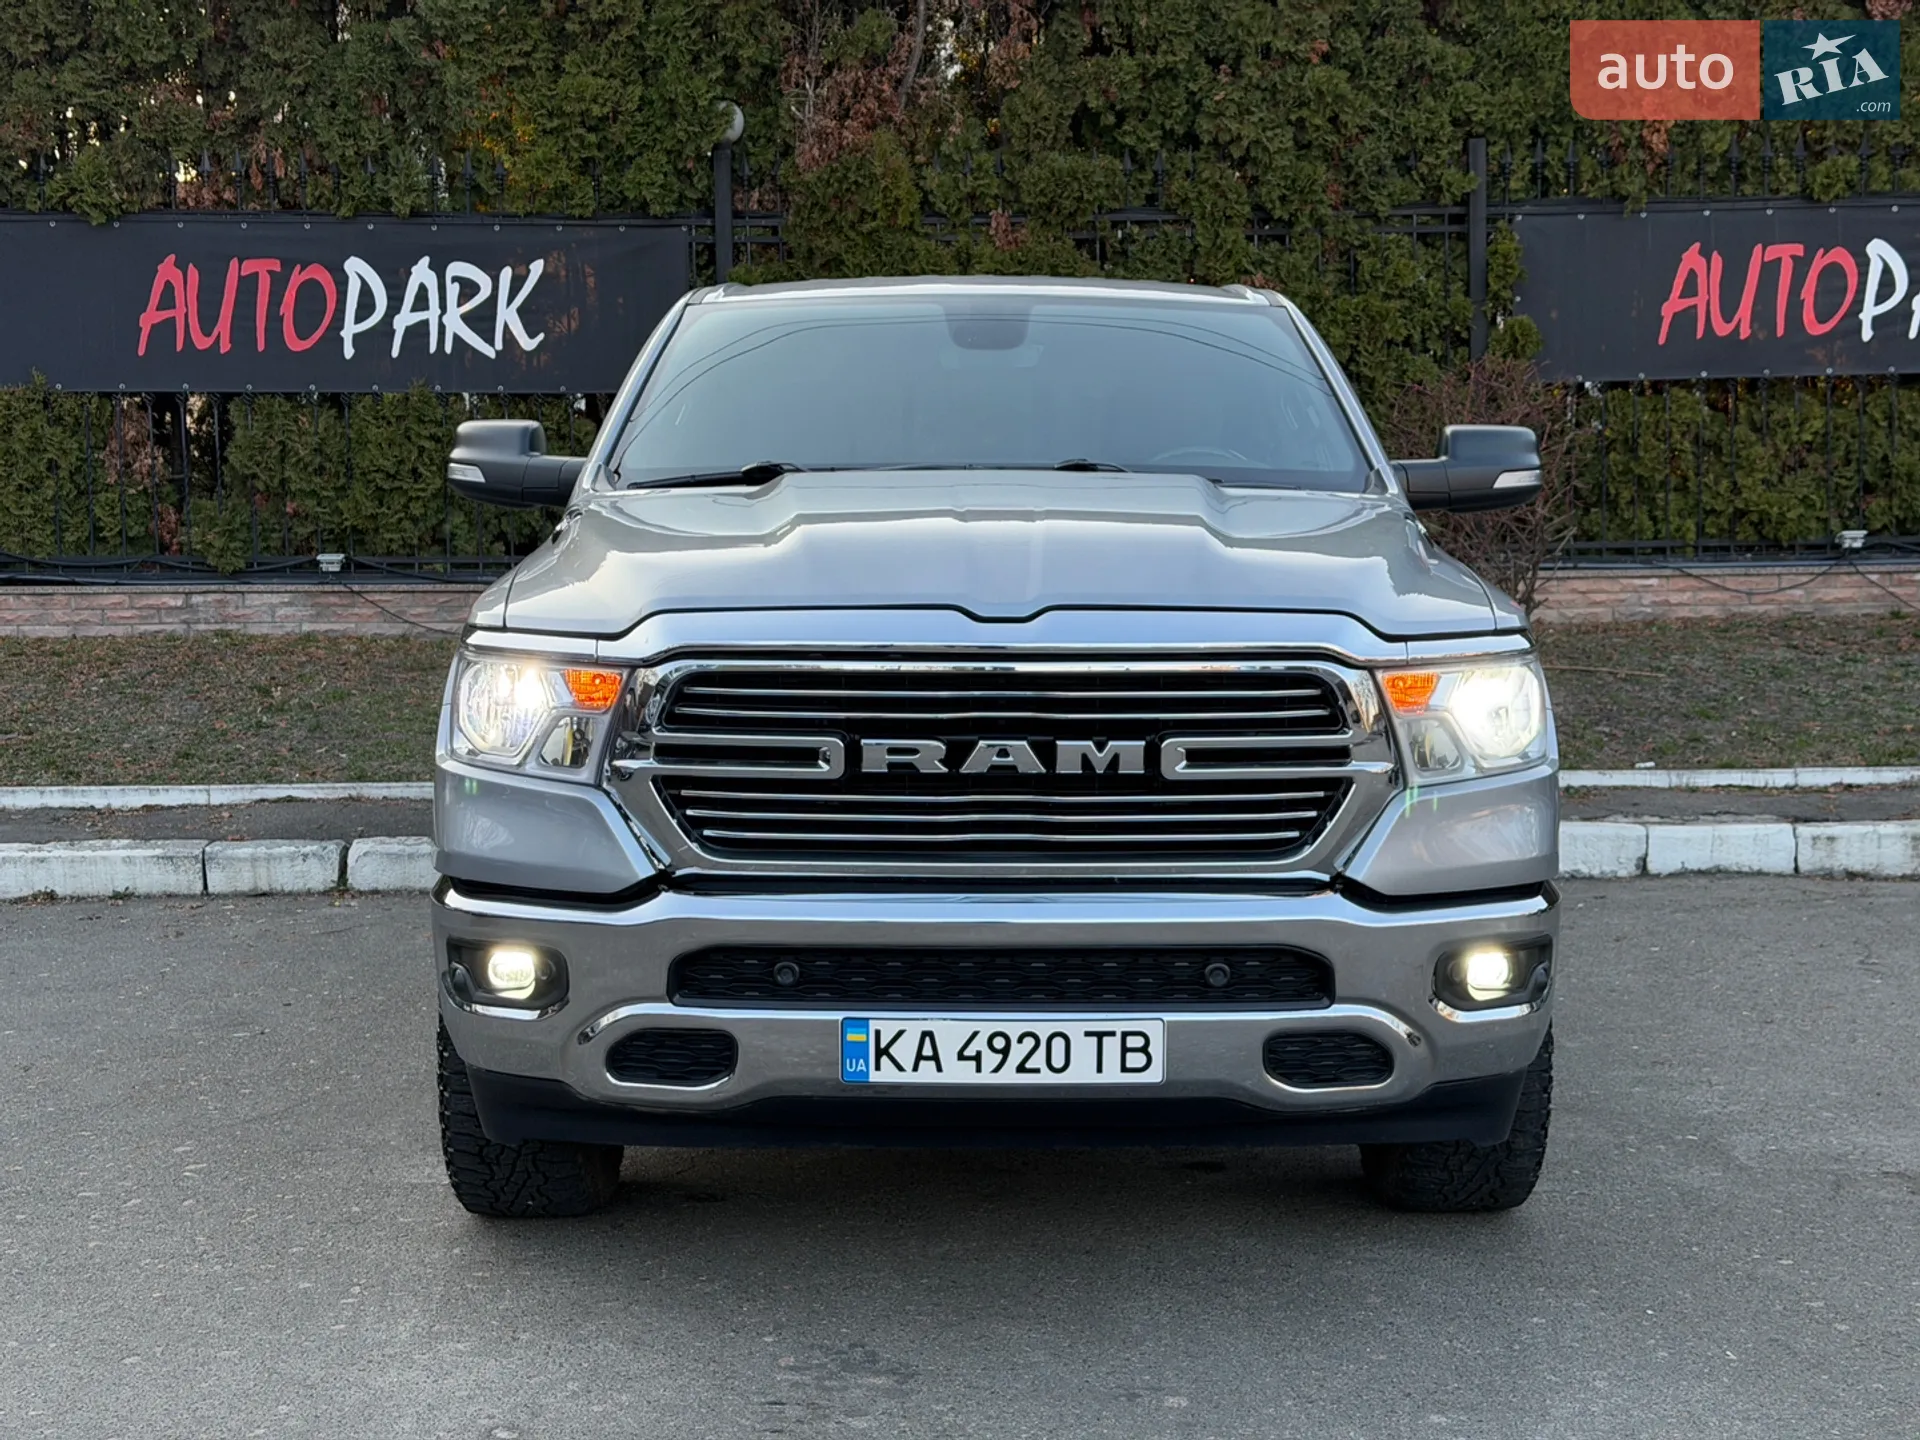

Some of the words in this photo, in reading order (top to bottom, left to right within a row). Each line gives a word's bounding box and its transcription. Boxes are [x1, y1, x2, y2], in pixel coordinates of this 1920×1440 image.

[137, 253, 545, 360] AUTOPARK
[1657, 237, 1920, 346] AUTOP
[860, 738, 1146, 774] RAM
[846, 1058, 867, 1072] UA
[874, 1028, 944, 1073] KA
[956, 1030, 1071, 1074] 4920
[1083, 1030, 1153, 1074] TB
